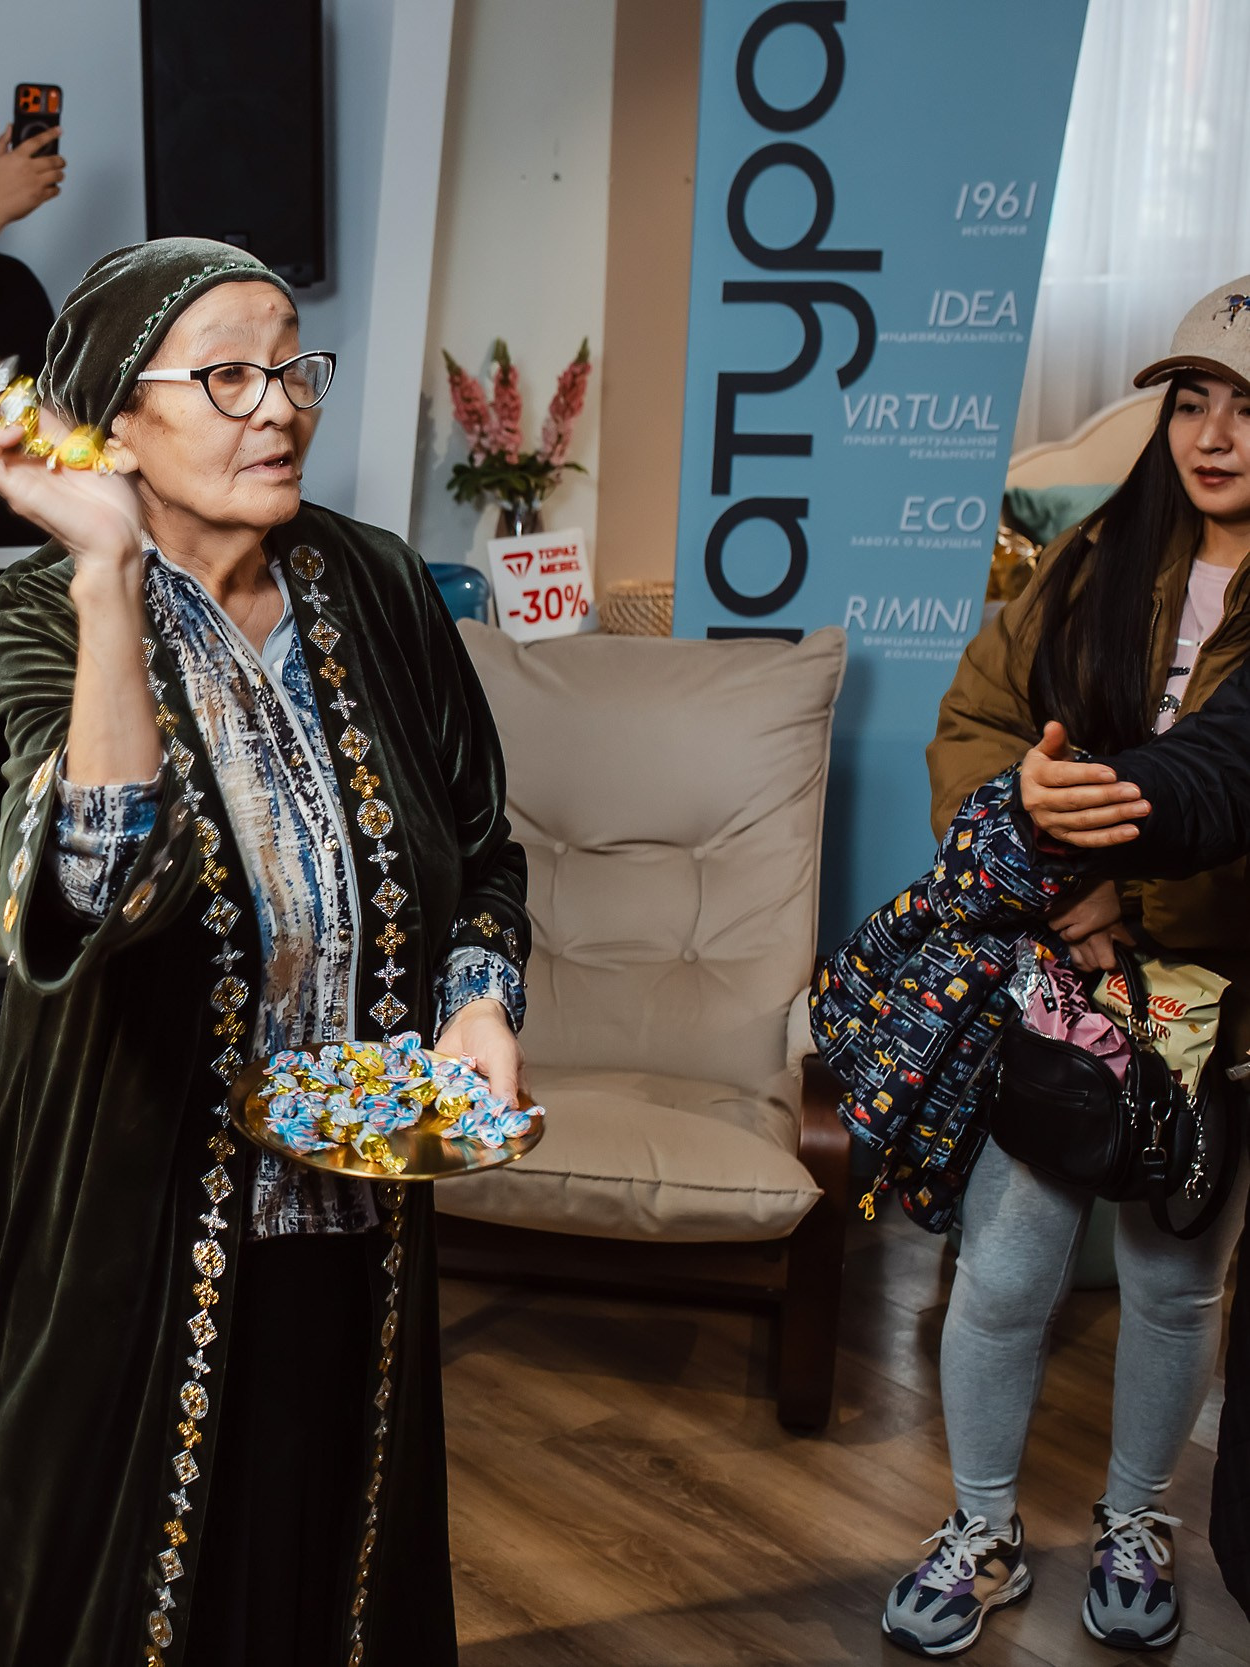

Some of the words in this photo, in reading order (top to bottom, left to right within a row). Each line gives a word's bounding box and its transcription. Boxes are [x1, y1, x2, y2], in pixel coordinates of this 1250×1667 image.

[955, 181, 1037, 221] 1961
[961, 225, 1028, 236] ИСТОРИЯ
[928, 289, 1018, 327] IDEA
[879, 331, 1024, 344] ИНДИВИДУАЛЬНОСТЬ
[843, 394, 1000, 431] VIRTUAL
[842, 434, 896, 446] ПРОЕКТ
[899, 434, 998, 447] ВИРТУАЛЬНОЙ
[909, 449, 996, 460] РЕАЛЬНОСТИ
[900, 496, 987, 532] ECO
[851, 536, 899, 547] ЗАБОТА
[917, 537, 982, 549] БУДУЩЕМ
[538, 545, 577, 560] TOPAZ
[540, 561, 580, 575] MEBEL
[509, 583, 589, 625] -30%
[843, 595, 972, 633] RIMINI
[863, 636, 963, 648] ОФИЦИАЛЬНАЯ
